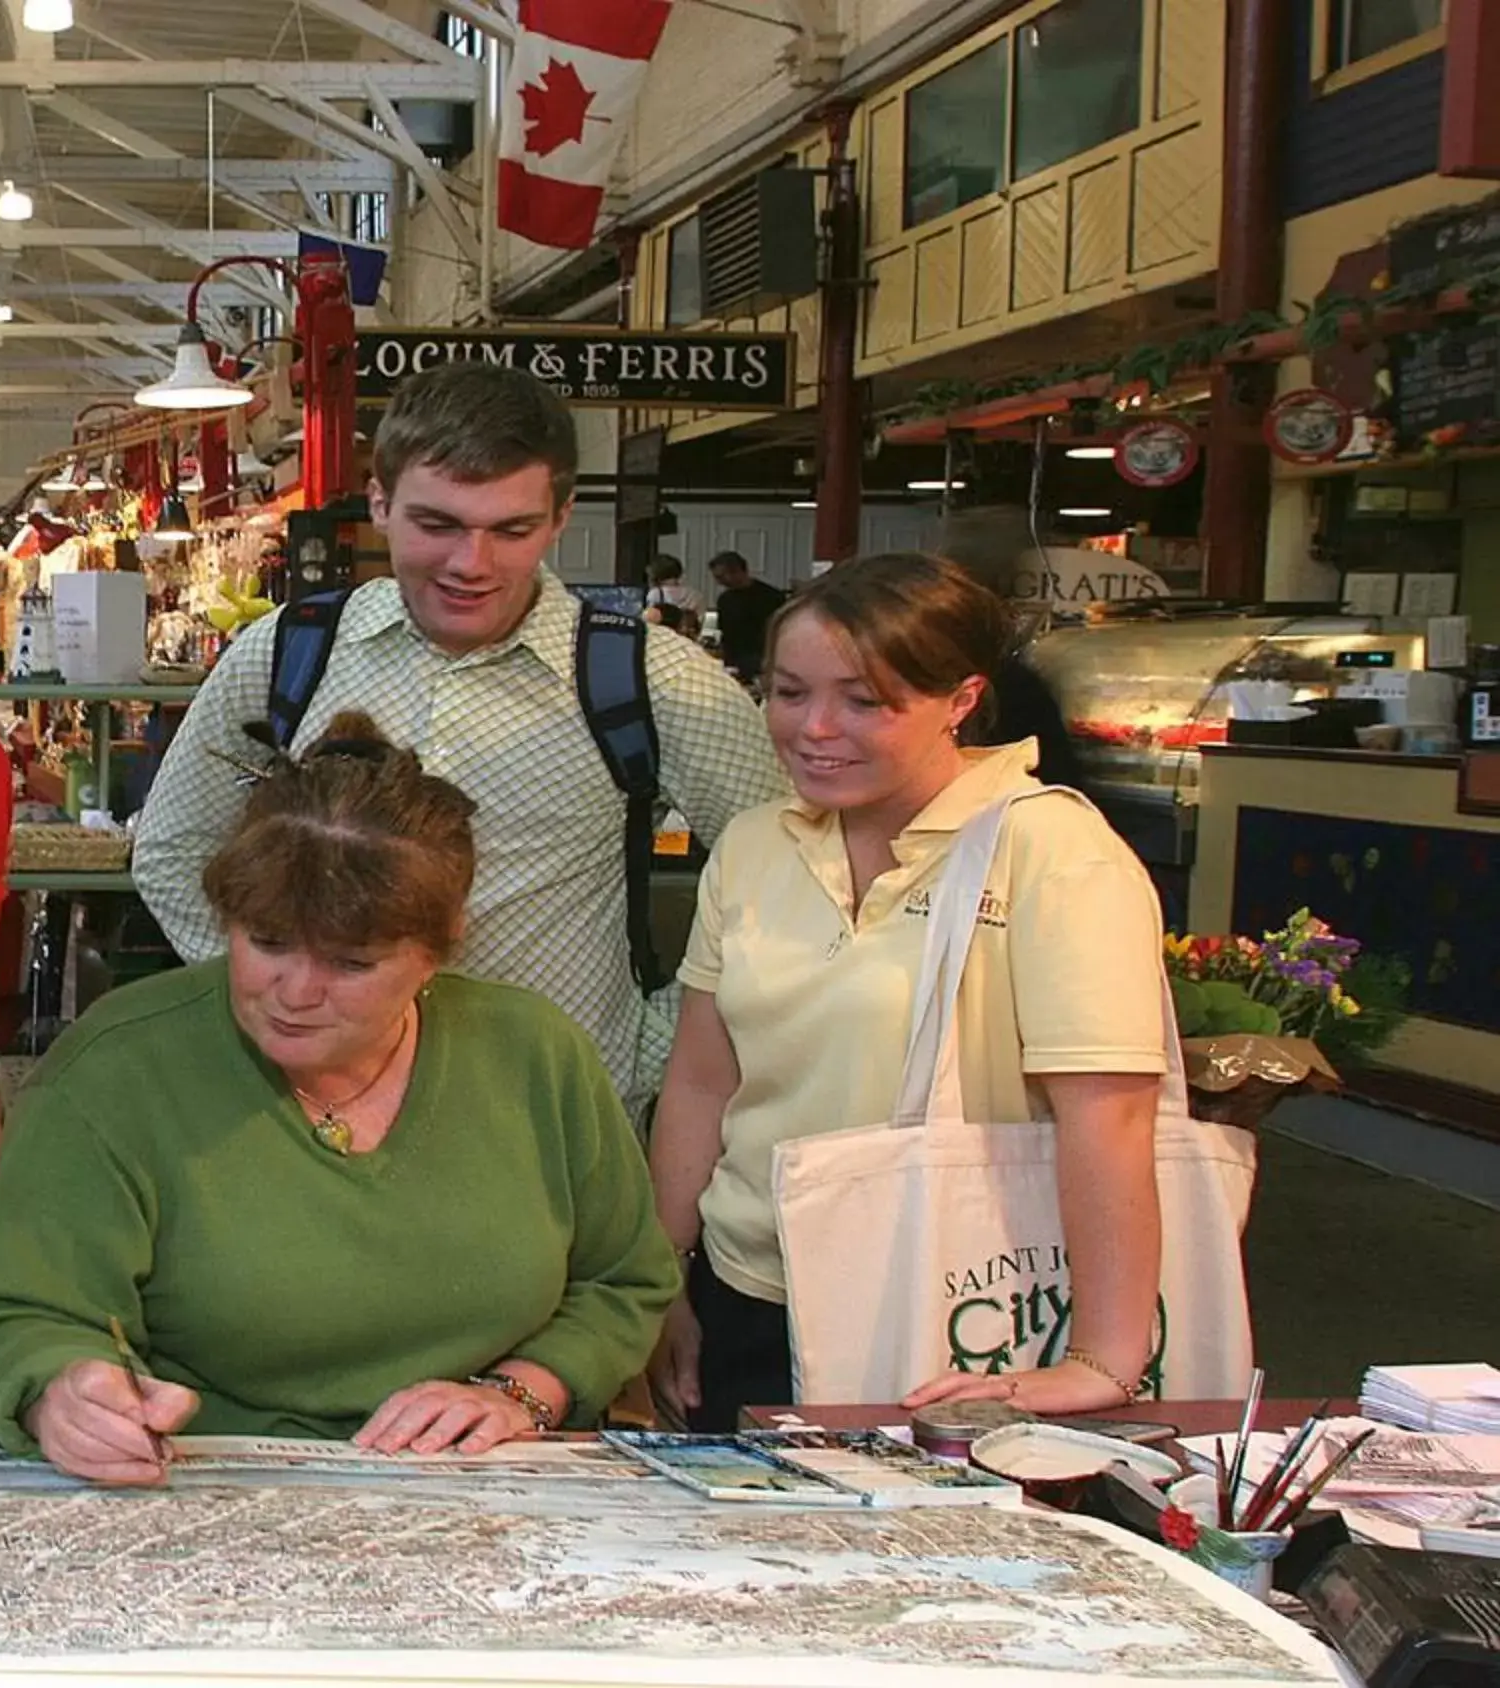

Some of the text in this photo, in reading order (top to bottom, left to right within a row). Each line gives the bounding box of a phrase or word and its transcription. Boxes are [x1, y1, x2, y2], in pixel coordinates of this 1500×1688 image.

[530, 343, 565, 379] &
[580, 343, 768, 388] FERRIS
[944, 1246, 1039, 1299] SAINT
[947, 1281, 1072, 1368] City
